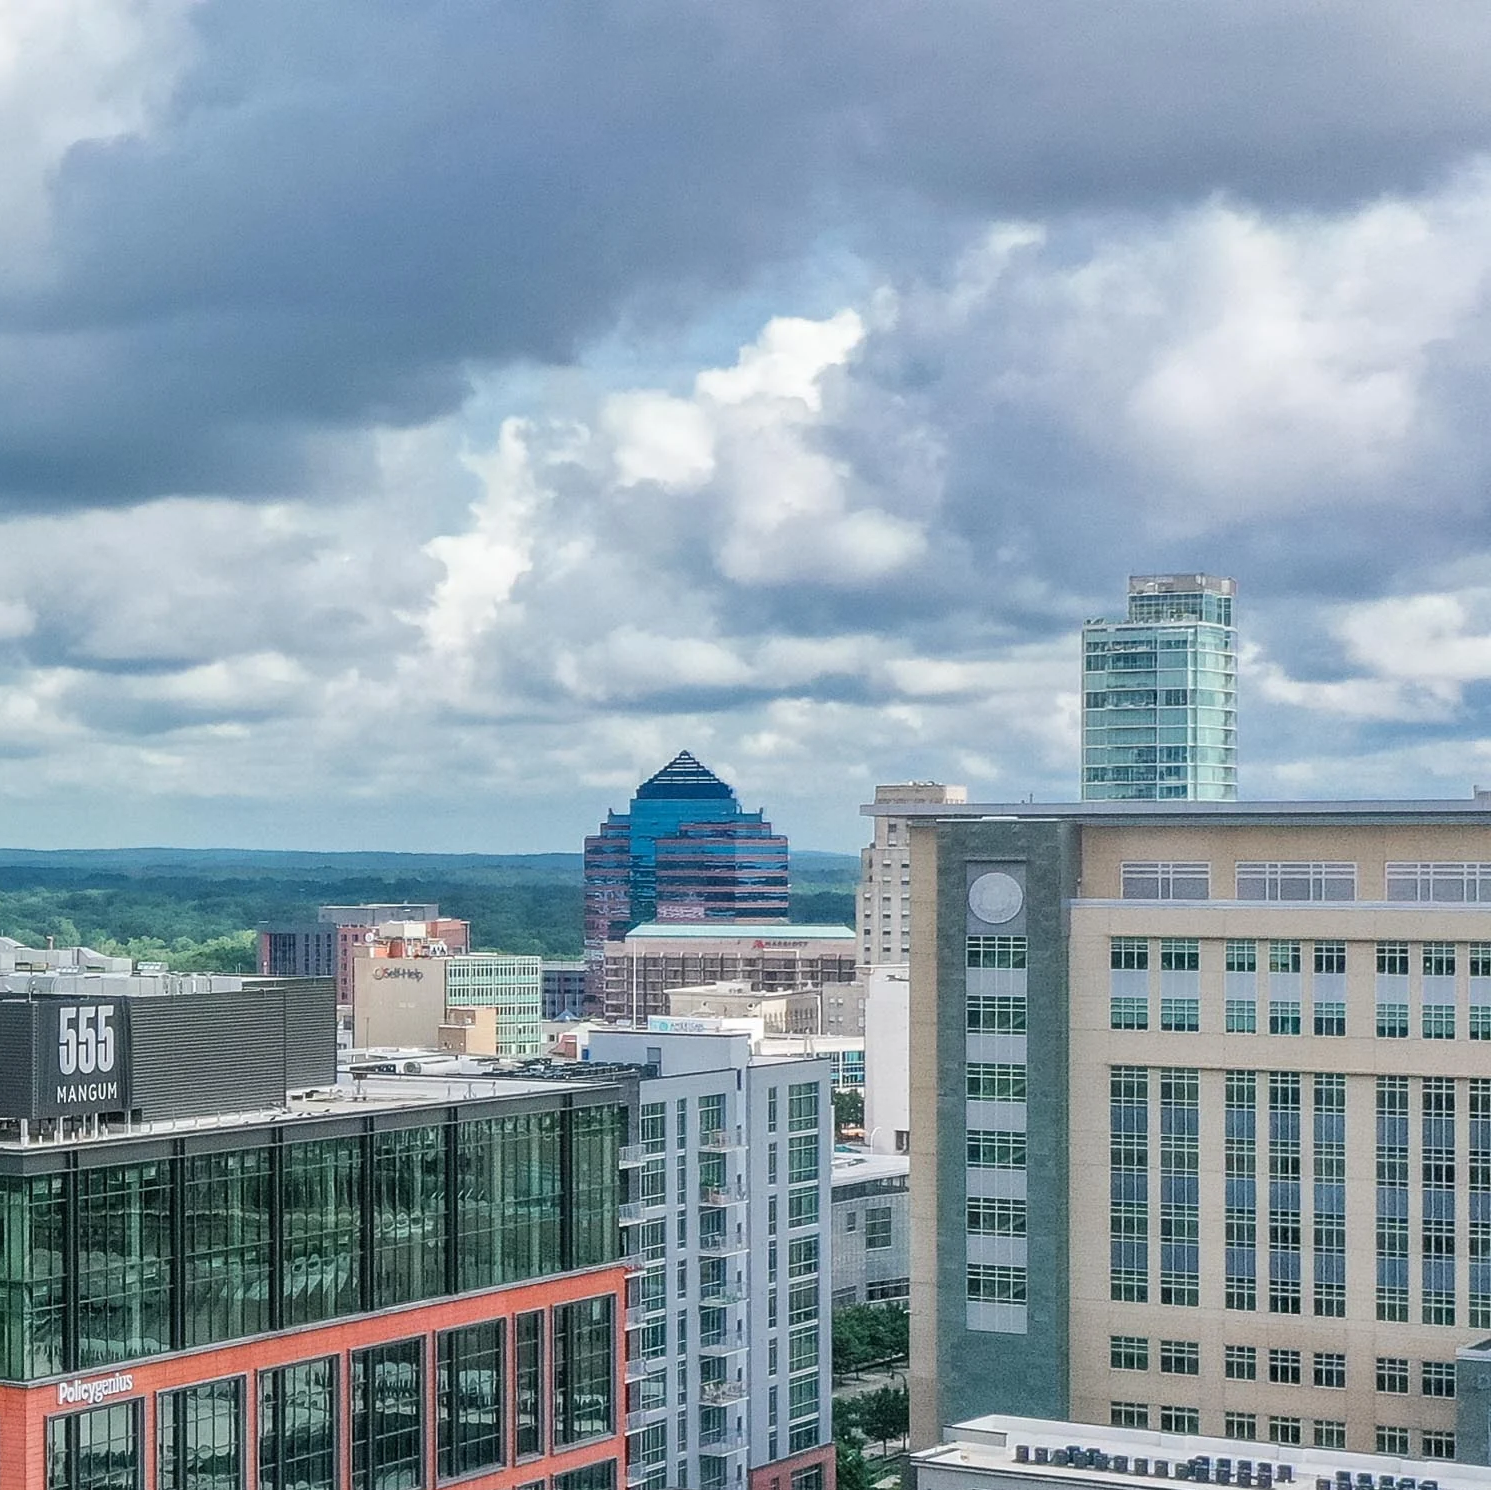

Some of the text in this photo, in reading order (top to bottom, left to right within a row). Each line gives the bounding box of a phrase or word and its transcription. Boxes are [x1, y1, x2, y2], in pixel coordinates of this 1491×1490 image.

[59, 1004, 115, 1076] 555
[56, 1080, 118, 1104] MANGUM
[57, 1372, 134, 1405] Policygenius
